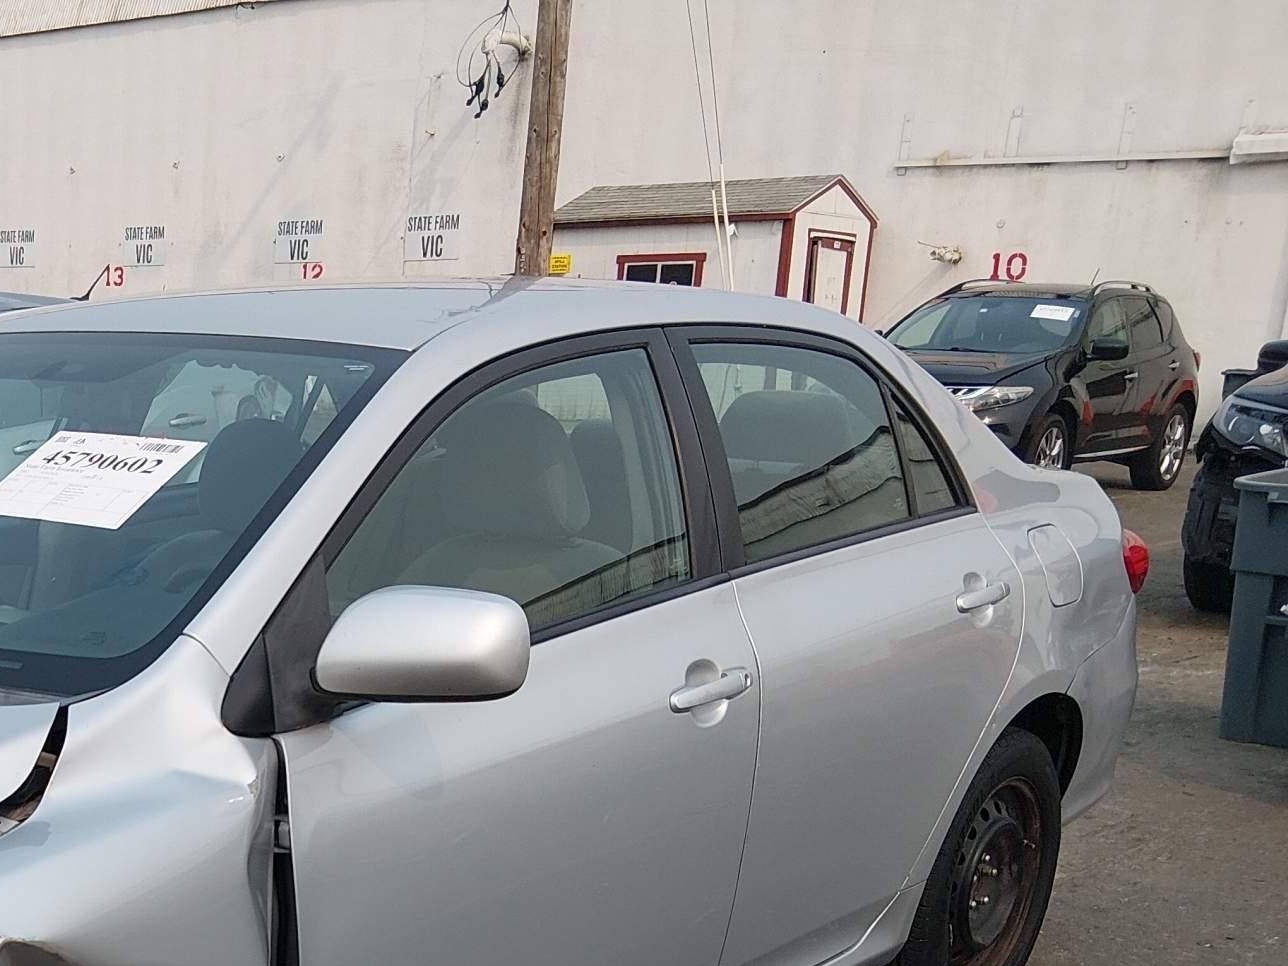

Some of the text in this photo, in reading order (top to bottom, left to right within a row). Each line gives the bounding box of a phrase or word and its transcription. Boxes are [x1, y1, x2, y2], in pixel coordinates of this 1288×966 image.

[278, 219, 323, 236] STATE FARM
[408, 214, 460, 232] STATE FARM
[0, 230, 35, 244] STATE FARM
[124, 226, 165, 241] STATE FARM
[9, 246, 25, 265] VIC
[135, 244, 153, 264] VIC
[289, 239, 309, 260] VIC
[421, 234, 443, 258] VIC
[105, 266, 124, 287] 13
[990, 252, 1028, 281] 10
[42, 450, 164, 474] 45790602
